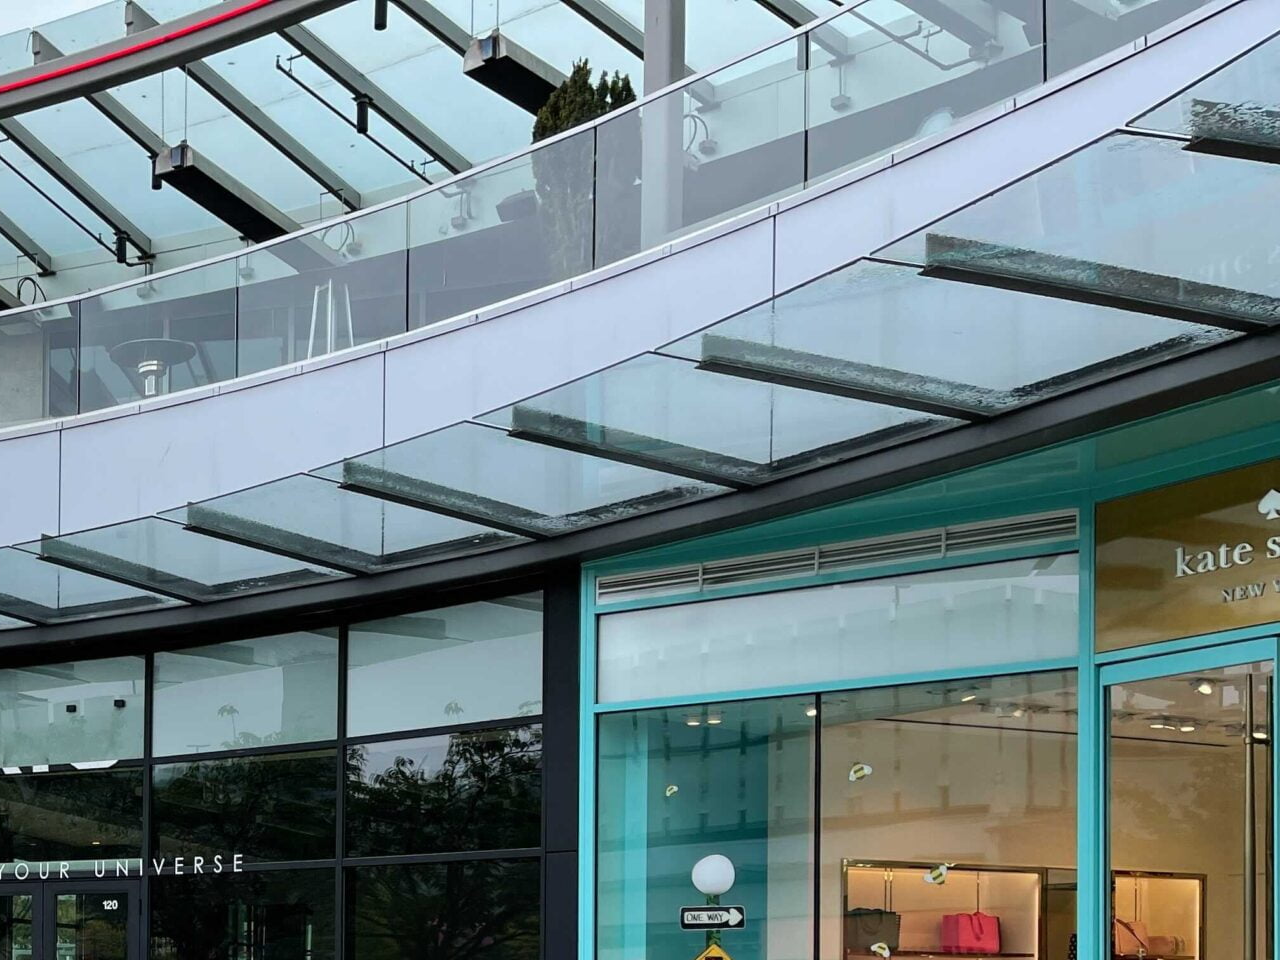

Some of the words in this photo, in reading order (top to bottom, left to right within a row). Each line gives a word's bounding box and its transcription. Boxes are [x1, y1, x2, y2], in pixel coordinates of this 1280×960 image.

[1175, 541, 1254, 578] kate
[1222, 582, 1266, 603] NEW
[94, 853, 244, 877] UNIVERSE
[102, 899, 119, 911] 120
[686, 913, 704, 922] ONE
[707, 913, 725, 922] WAY
